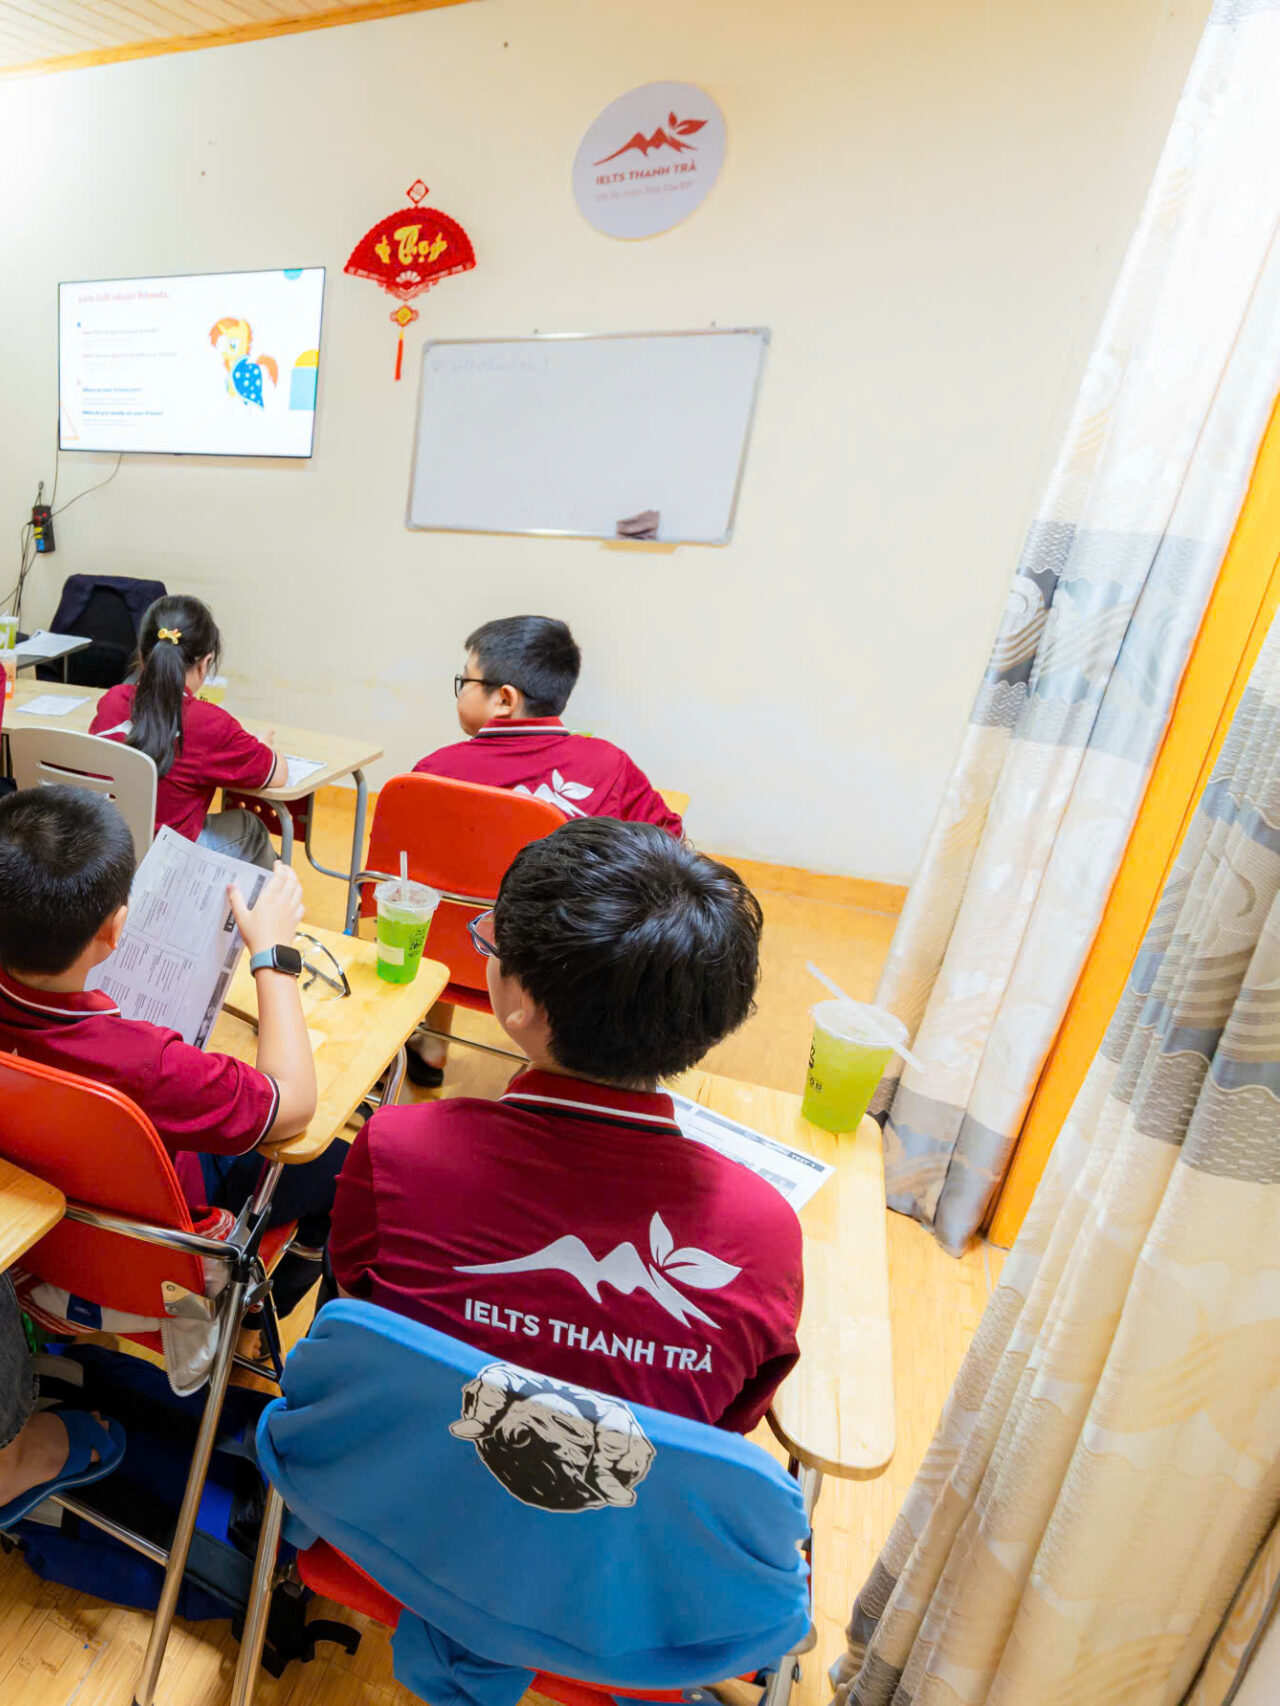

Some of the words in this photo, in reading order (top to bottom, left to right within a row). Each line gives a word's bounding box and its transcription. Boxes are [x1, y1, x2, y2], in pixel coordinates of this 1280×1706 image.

[596, 172, 625, 185] IELTS
[629, 165, 670, 180] THANH
[465, 1298, 540, 1337] IELTS
[548, 1318, 655, 1365] THANH
[663, 1344, 713, 1373] TRÀ
